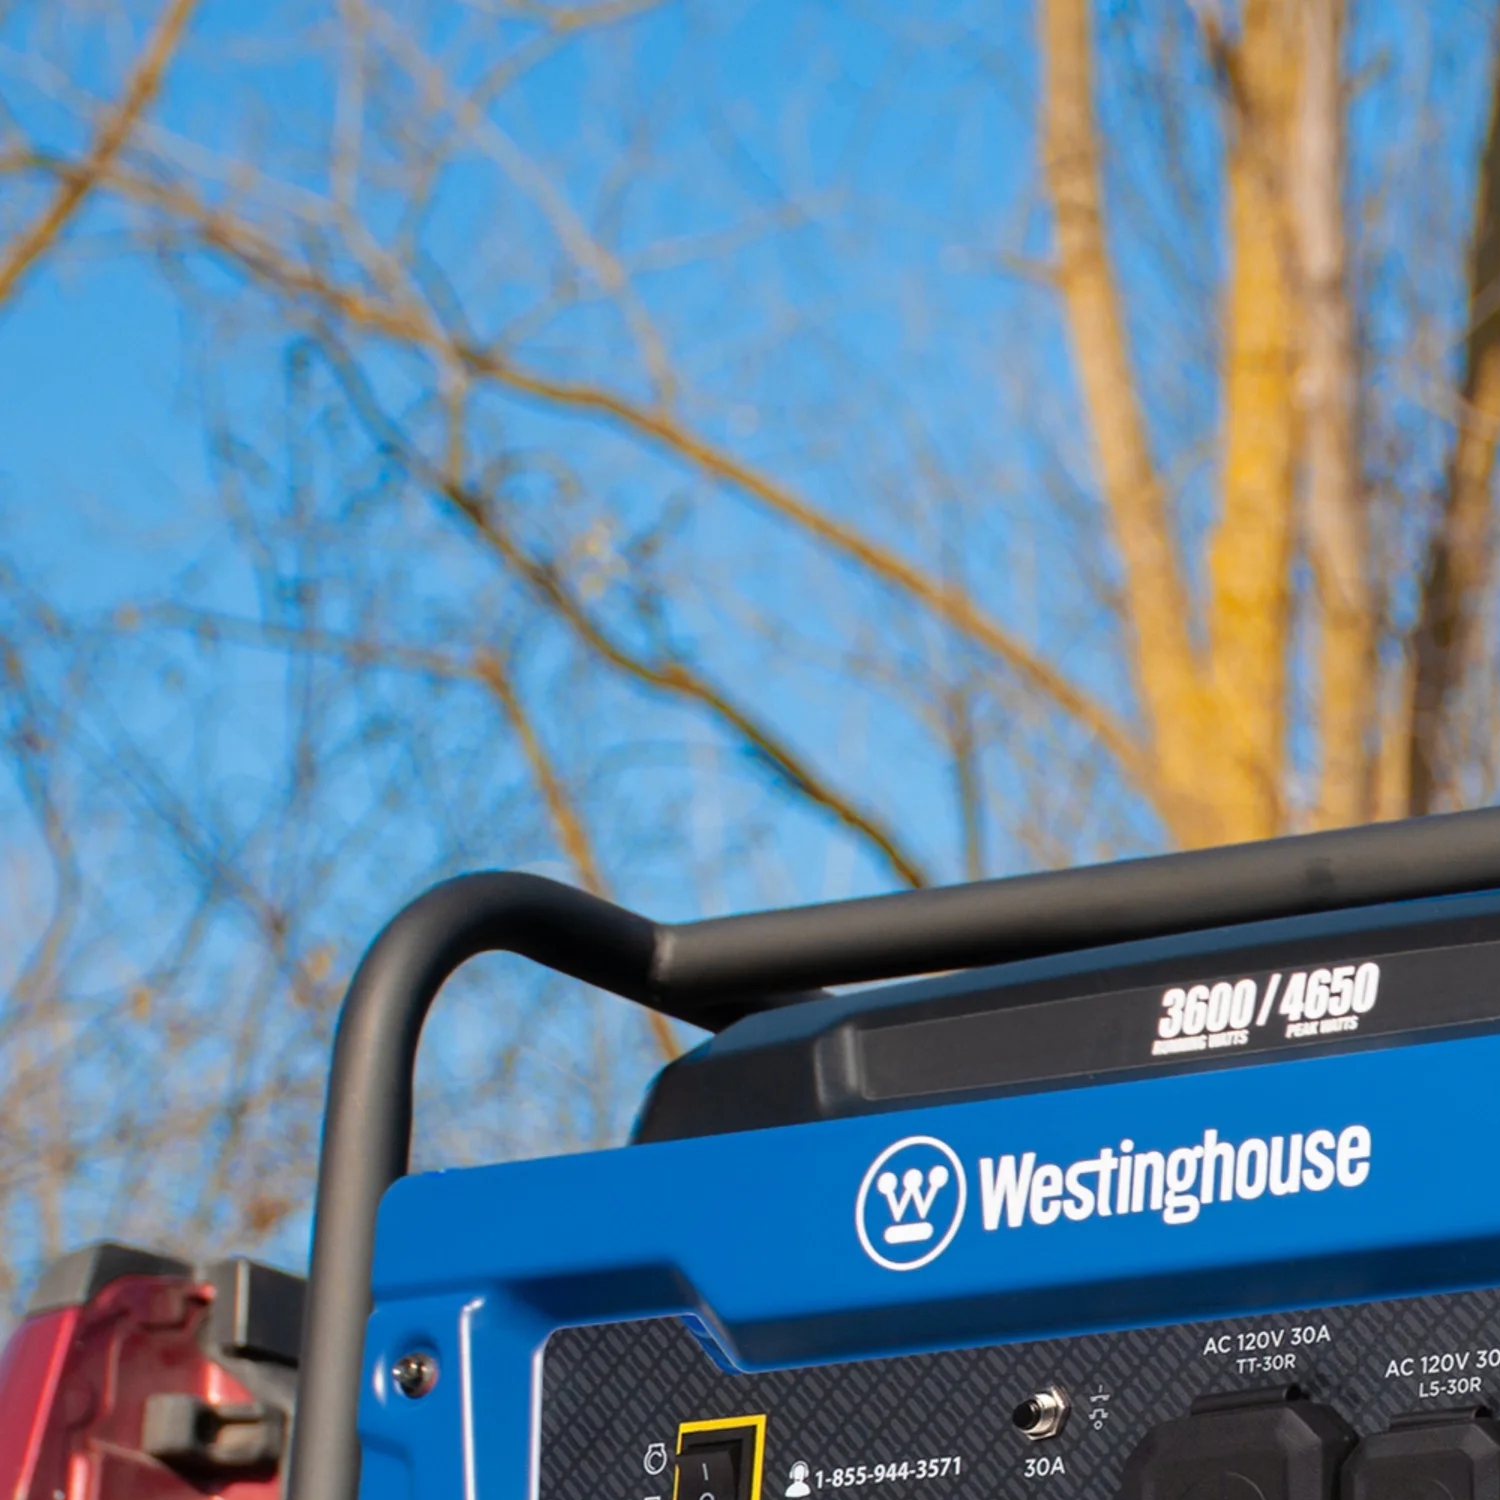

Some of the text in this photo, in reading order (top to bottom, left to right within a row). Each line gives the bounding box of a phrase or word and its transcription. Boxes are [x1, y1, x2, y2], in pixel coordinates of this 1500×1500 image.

[1285, 1016, 1359, 1039] PEAK WATTS
[1208, 1030, 1249, 1049] WATTS
[980, 1124, 1372, 1231] Westinghouse
[1203, 1324, 1331, 1355] AC 120V 30A
[1236, 1353, 1296, 1374] TT-30R
[1385, 1358, 1414, 1378] AC
[1420, 1352, 1470, 1374] 120V
[1419, 1376, 1482, 1398] L5-30R
[815, 1456, 962, 1489] 1-855-944-3571
[1024, 1456, 1065, 1478] 30A
